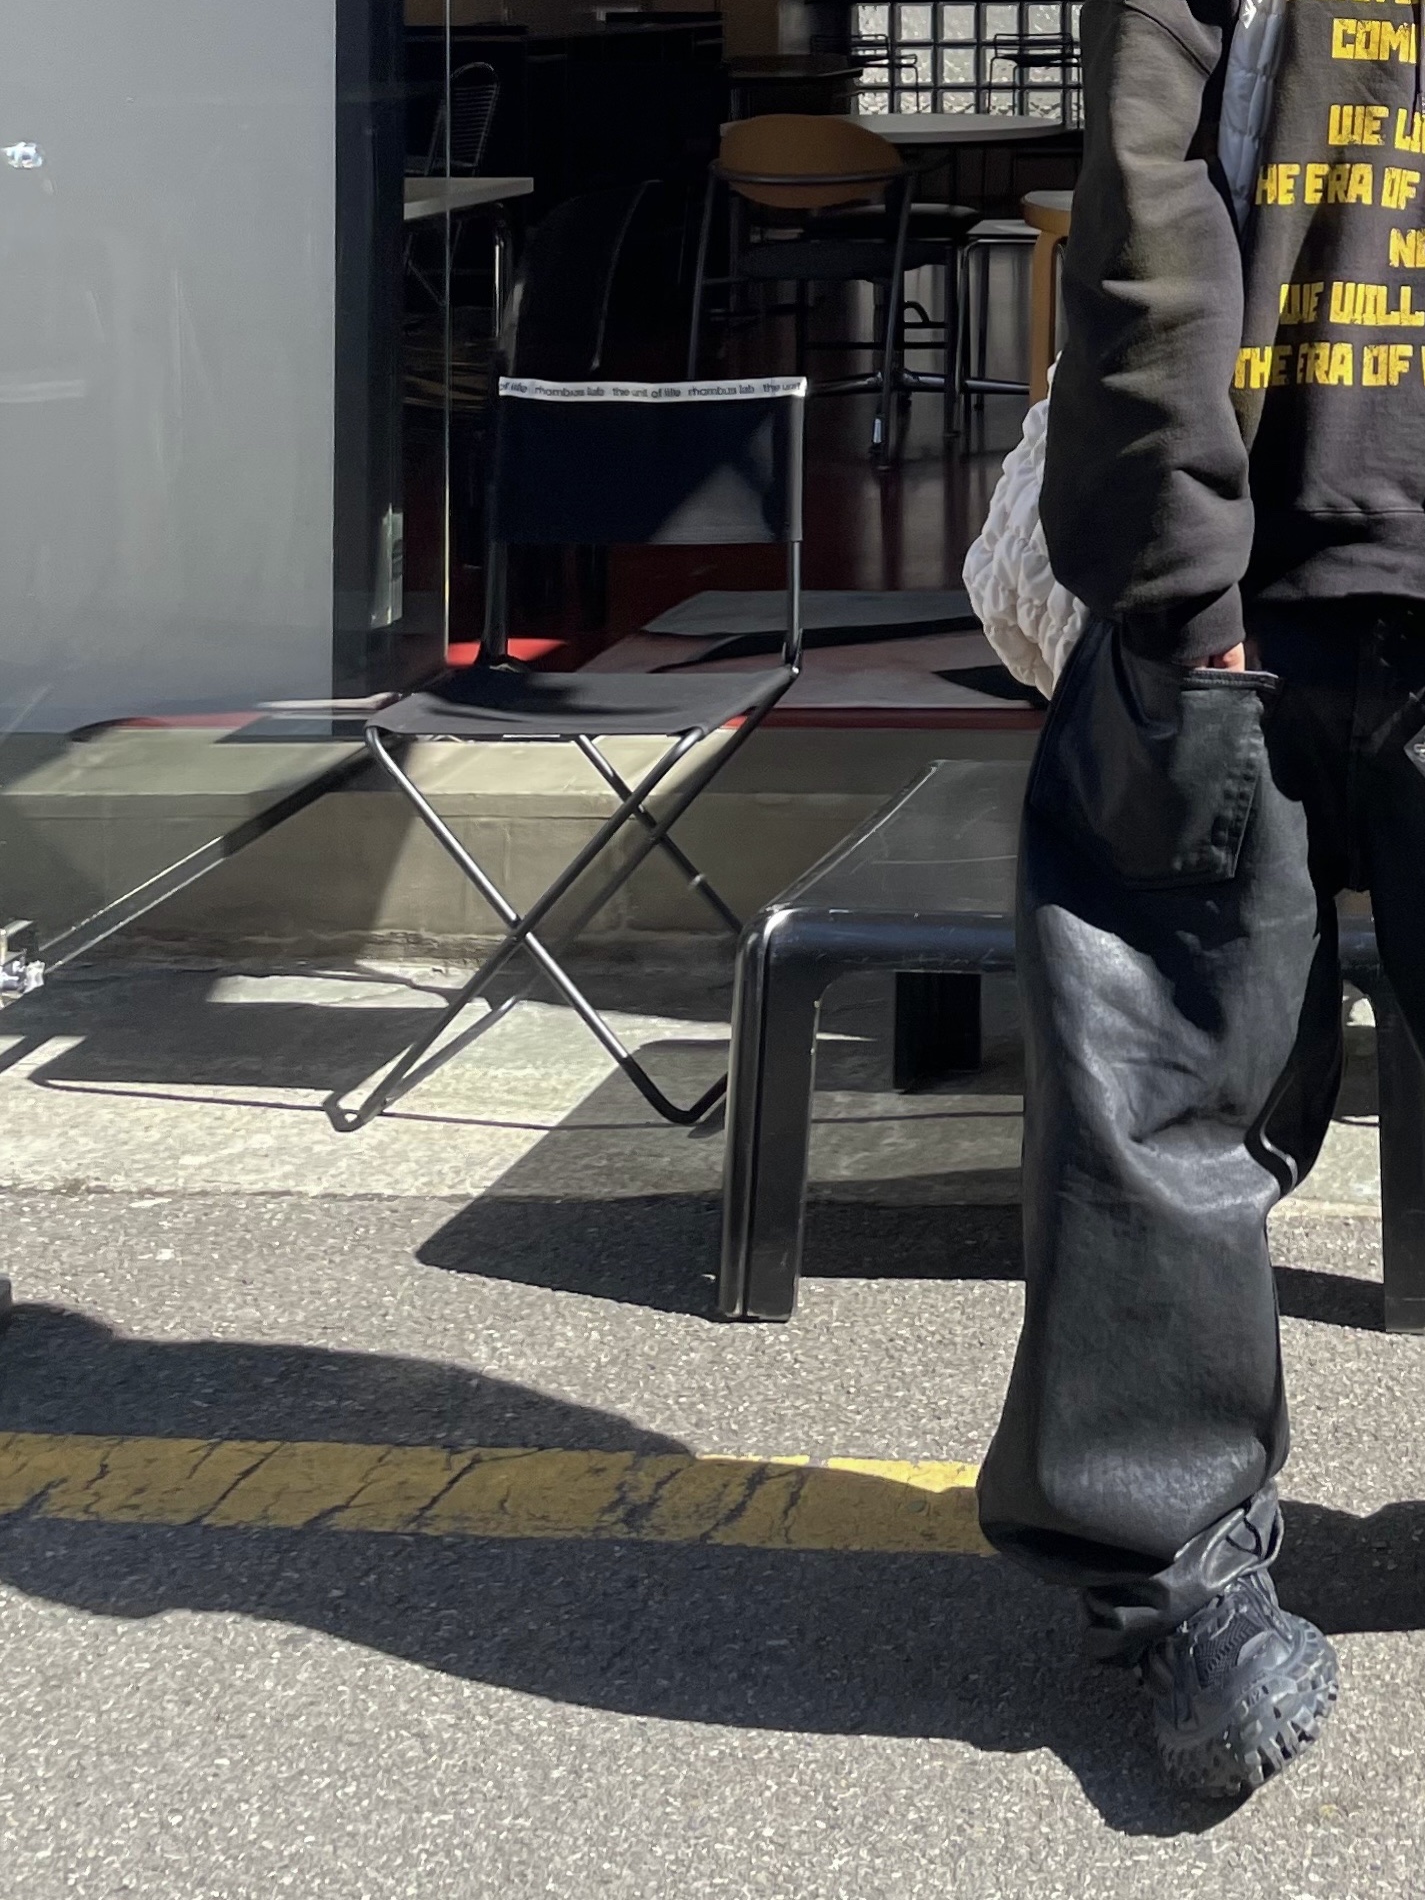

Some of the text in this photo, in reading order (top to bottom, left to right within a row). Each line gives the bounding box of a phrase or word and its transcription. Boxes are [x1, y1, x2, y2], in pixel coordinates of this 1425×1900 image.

[1328, 105, 1389, 145] WE
[1255, 163, 1300, 205] HE
[1304, 163, 1373, 205] ERA
[1381, 166, 1420, 210] OF
[1279, 282, 1324, 325] WE
[1330, 281, 1425, 327] WILL
[1234, 345, 1293, 389] THE
[1296, 342, 1354, 386] ERA
[1362, 344, 1413, 387] OF
[688, 386, 737, 397] rhombus
